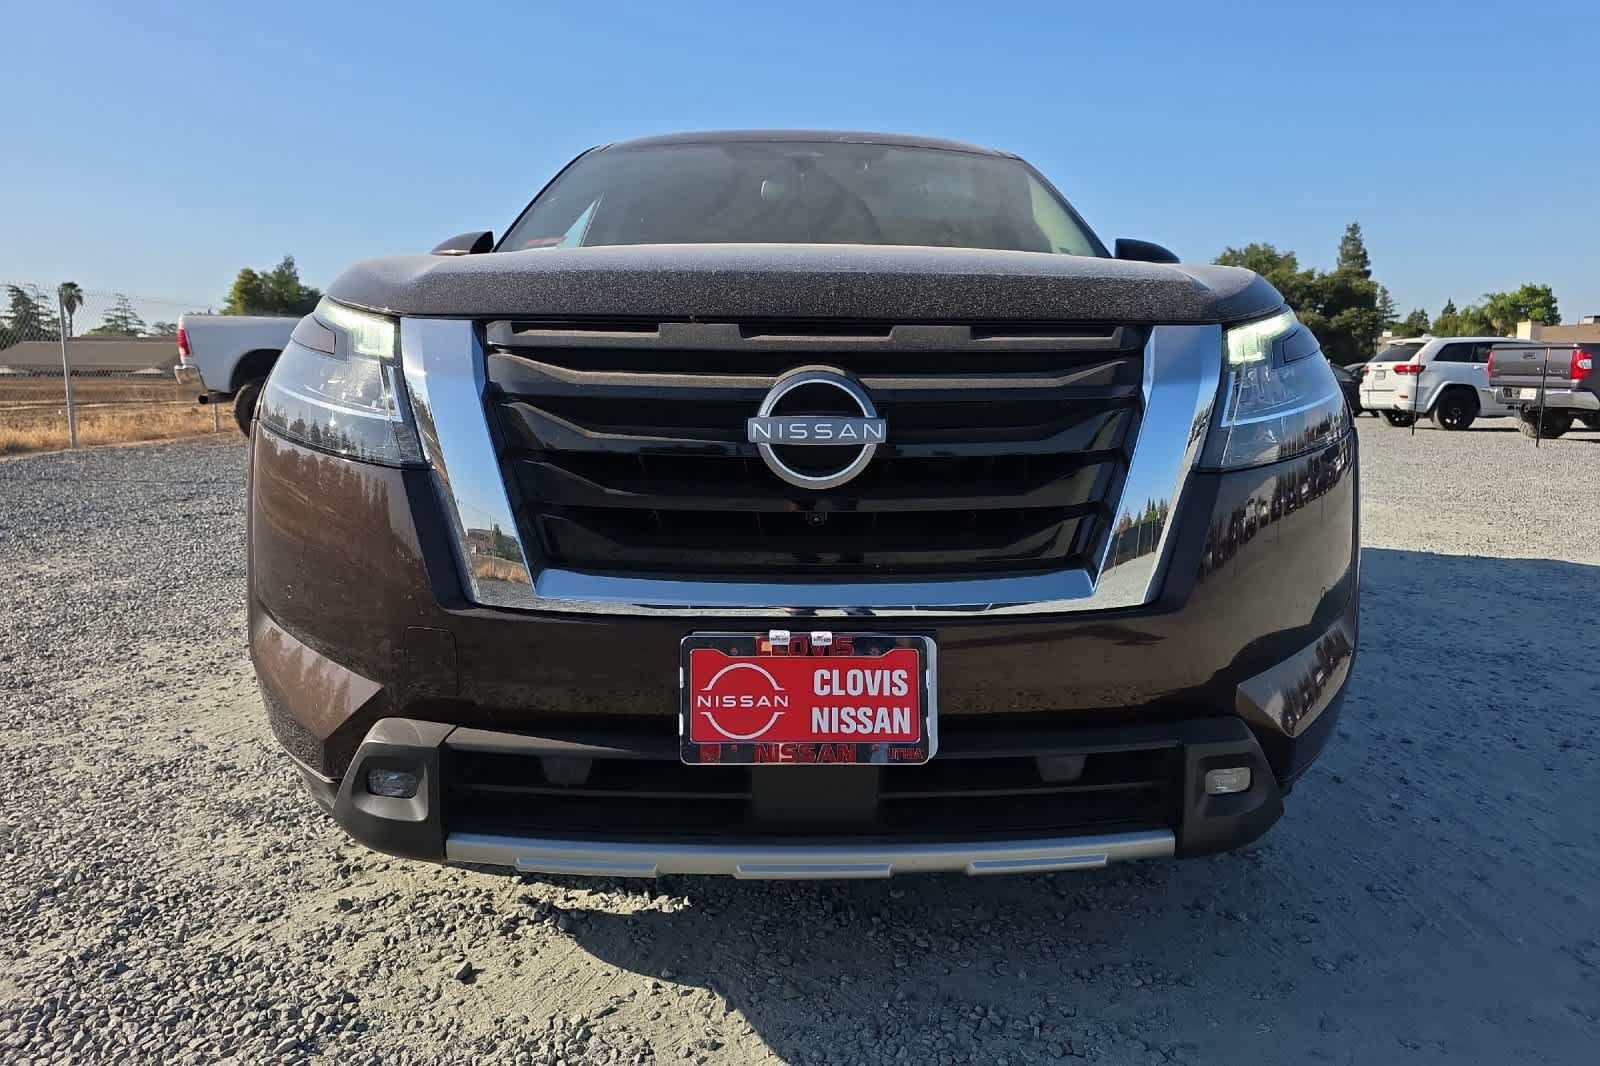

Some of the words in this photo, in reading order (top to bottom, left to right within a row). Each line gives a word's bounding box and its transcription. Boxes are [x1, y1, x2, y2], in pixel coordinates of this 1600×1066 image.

[752, 423, 882, 439] NISSAN
[813, 669, 909, 697] CLOVIS
[697, 695, 789, 708] NISSAN
[811, 706, 911, 735] NISSAN
[753, 743, 857, 763] NISSAN
